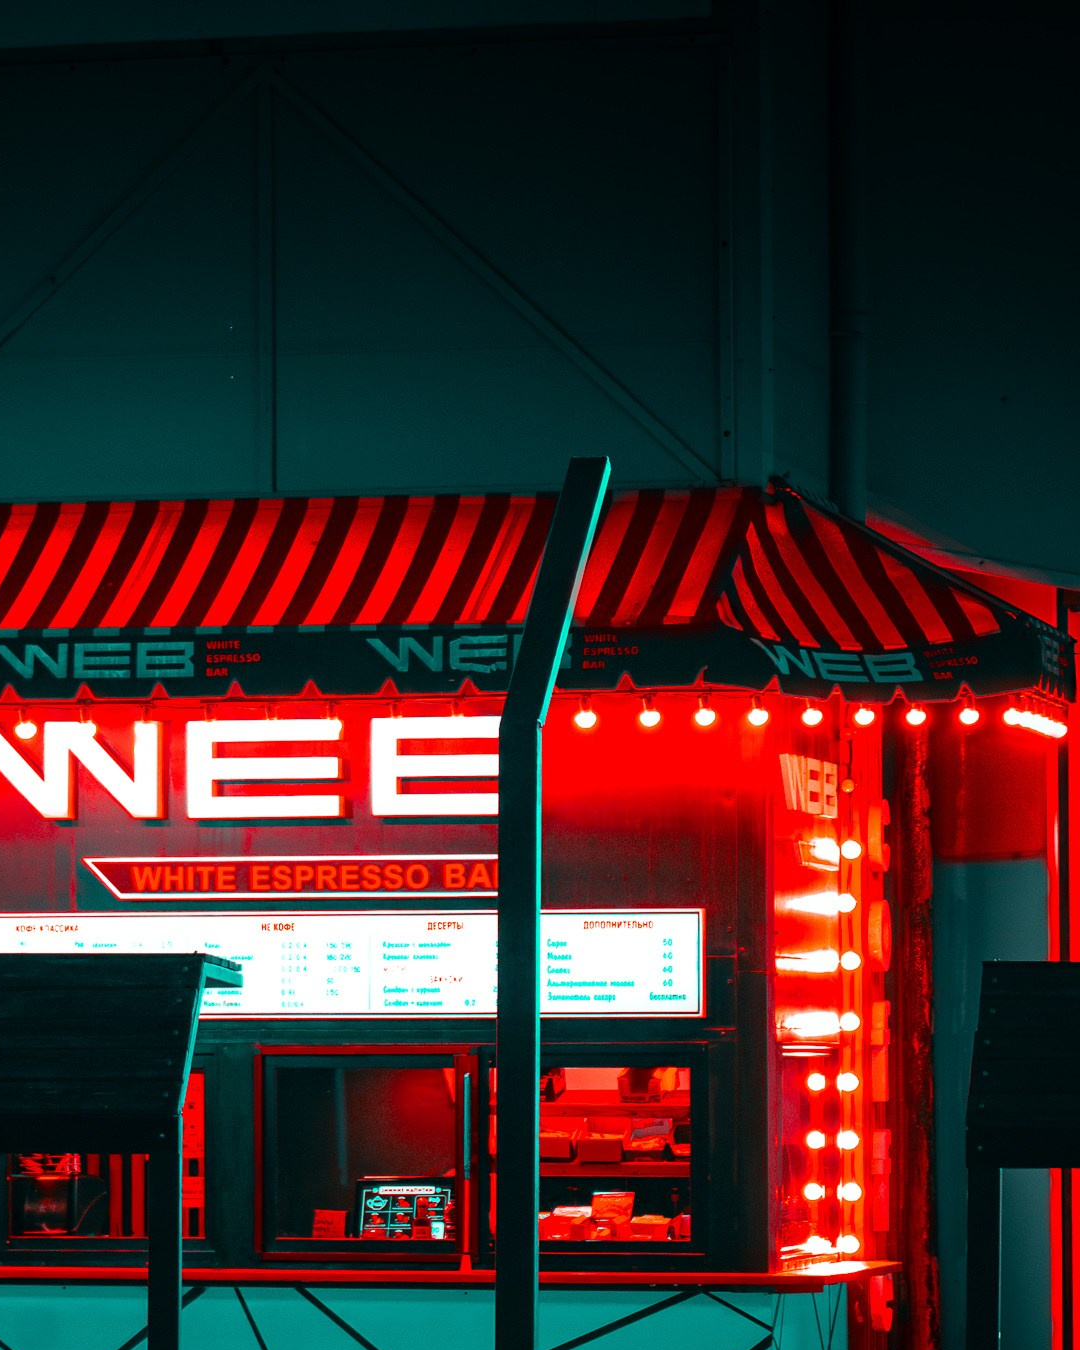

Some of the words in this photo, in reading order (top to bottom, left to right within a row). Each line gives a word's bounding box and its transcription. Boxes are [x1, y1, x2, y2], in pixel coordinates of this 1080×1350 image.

[584, 634, 618, 643] WHITE
[206, 640, 240, 650] WHITE
[583, 646, 638, 656] ESPRESSO
[206, 653, 261, 664] ESPRESSO
[749, 637, 924, 683] WEB
[582, 660, 605, 670] BAR
[205, 667, 229, 677] BAR
[779, 753, 838, 819] WEB
[132, 865, 236, 893] WHITE
[249, 863, 429, 892] ESPRESSO
[444, 863, 499, 890] BA
[261, 923, 271, 931] НЕ
[273, 922, 295, 931] КОФЕ
[427, 921, 464, 931] ДЕСЕРТЫ
[583, 920, 654, 930] ДОПОЛНИТЕЛЬНО
[662, 938, 673, 946] 50
[662, 965, 673, 974] 60
[662, 978, 673, 987] 60
